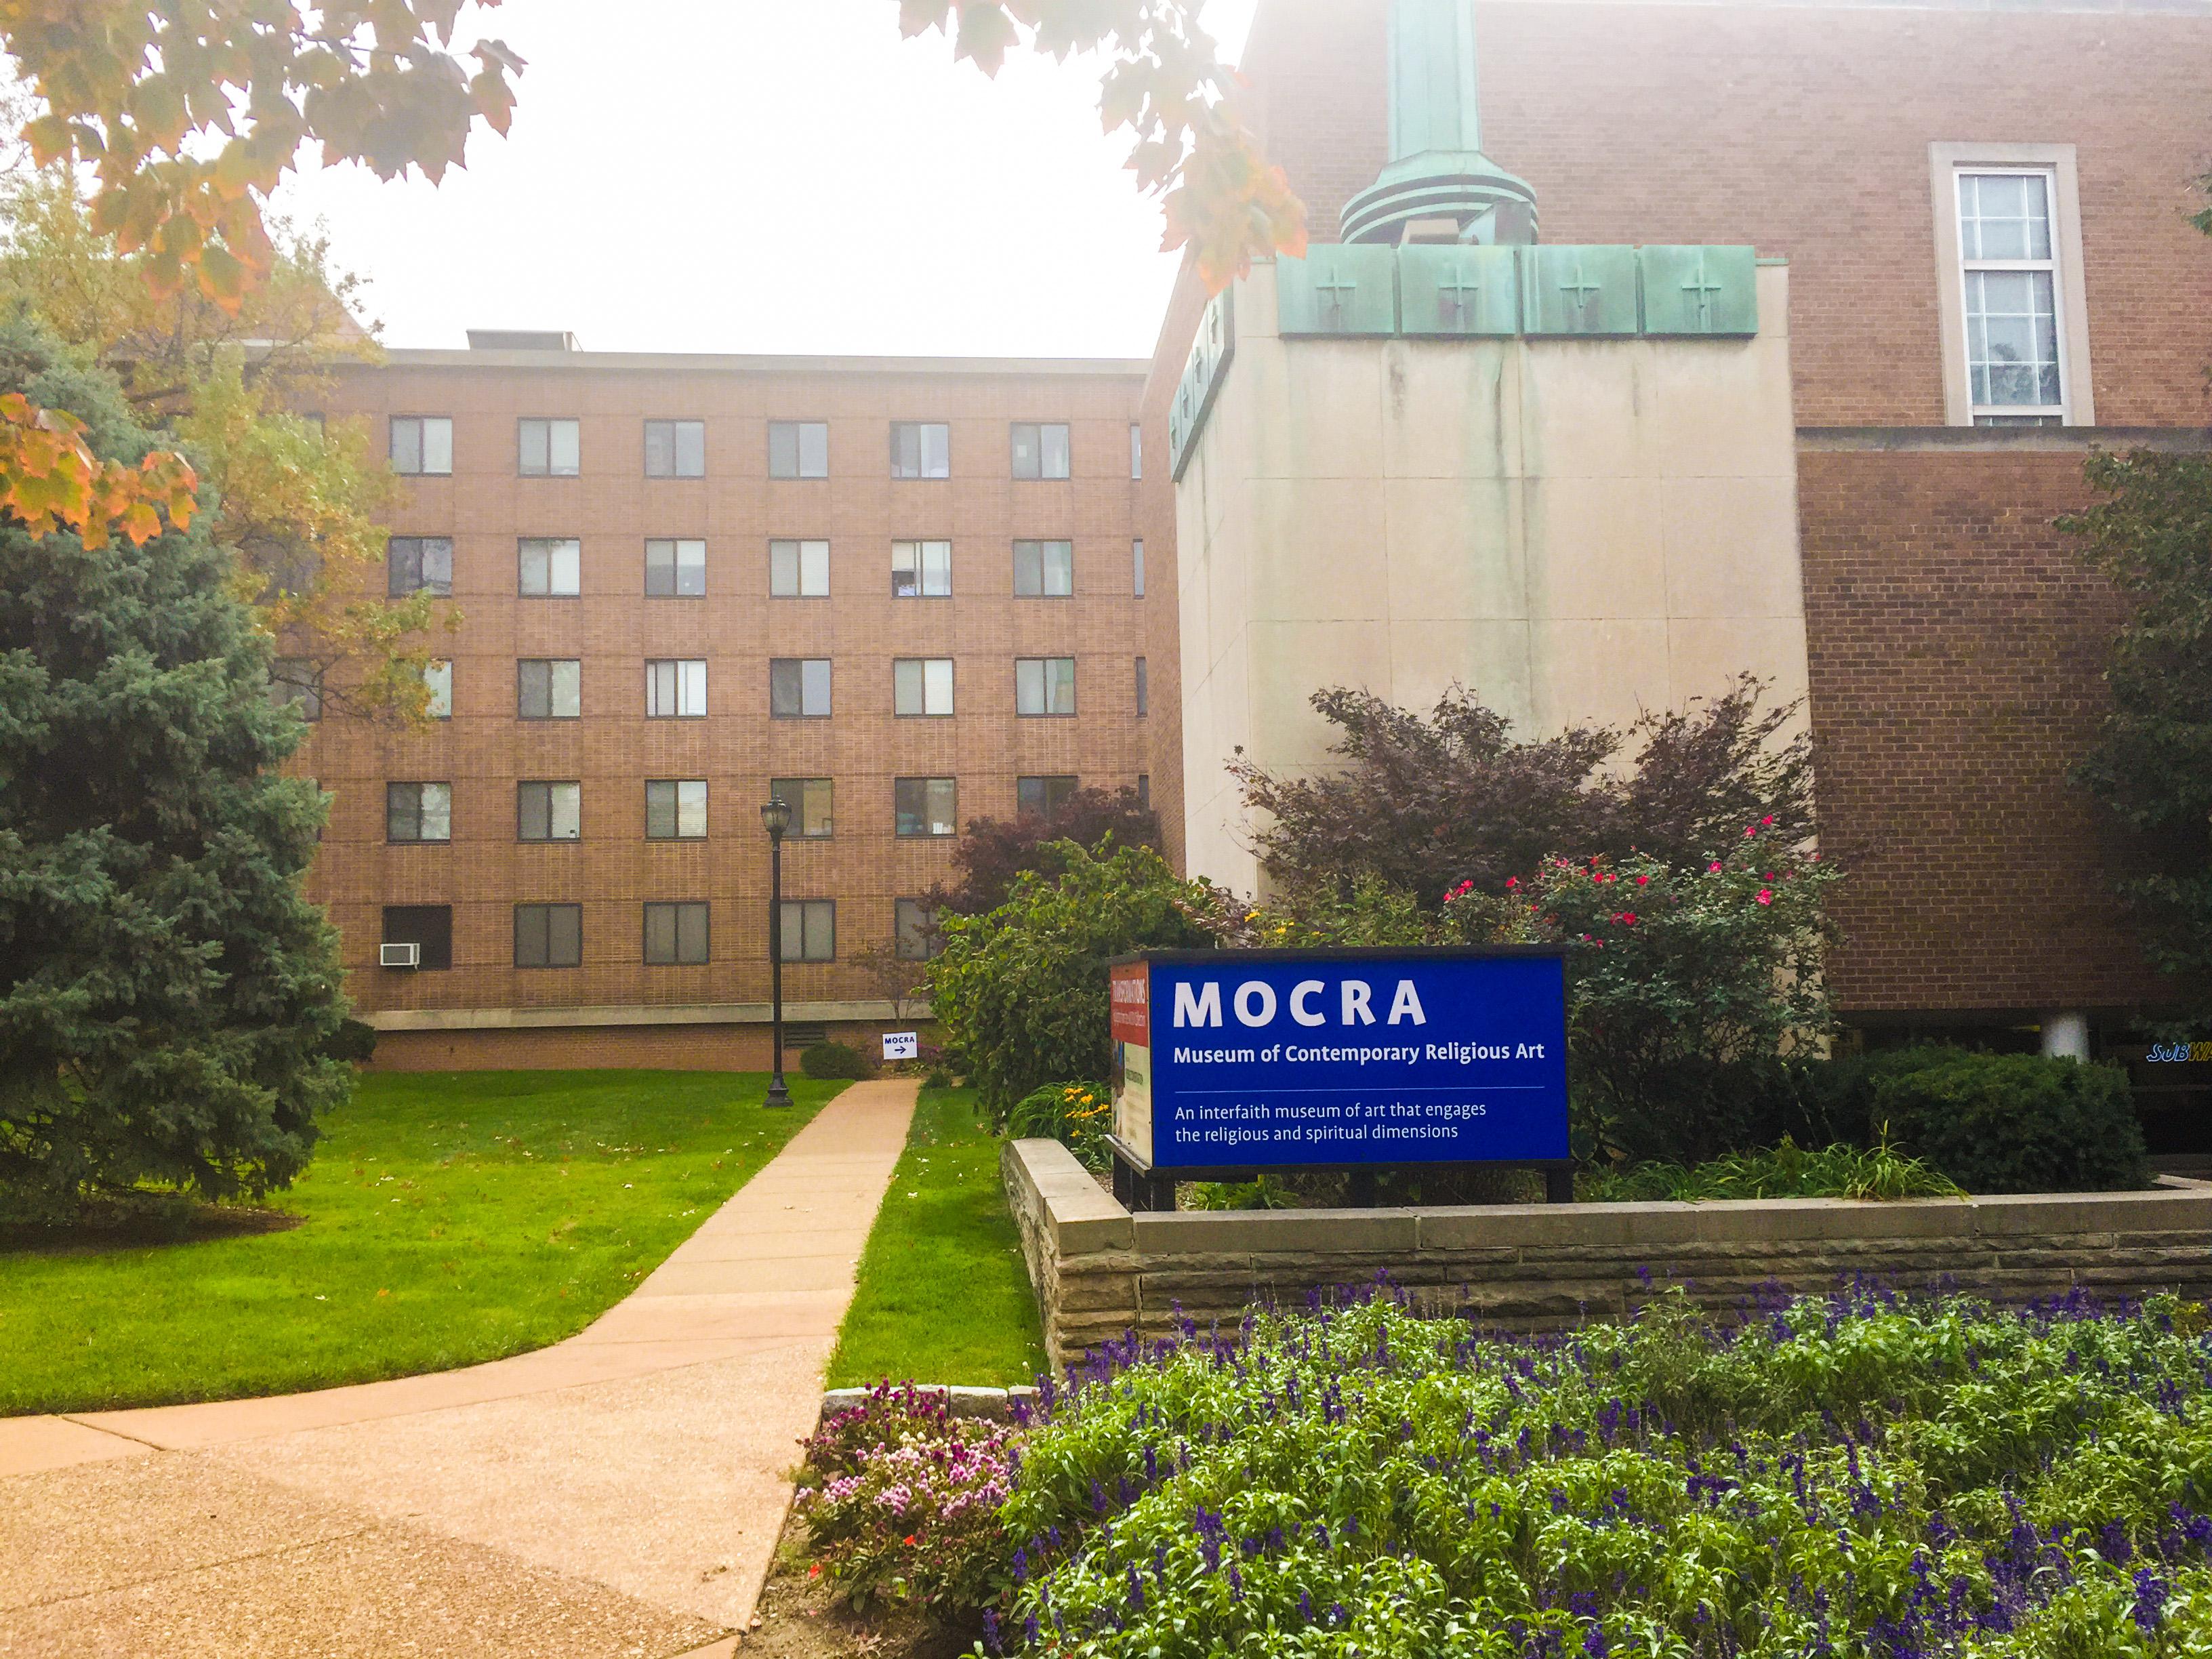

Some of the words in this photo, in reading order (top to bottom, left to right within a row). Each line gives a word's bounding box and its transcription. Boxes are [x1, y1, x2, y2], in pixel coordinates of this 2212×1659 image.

[1173, 979, 1427, 1027] MOCRA
[884, 1036, 915, 1044] MOCRA
[1174, 1047, 1255, 1063] Museum
[1261, 1044, 1281, 1063] of
[1285, 1045, 1420, 1066] Contemporary
[1426, 1042, 1510, 1065] Religious
[1515, 1043, 1545, 1059] Art
[1174, 1107, 1194, 1120] An
[1200, 1103, 1270, 1120] interfaith
[1275, 1107, 1340, 1118] museum
[1345, 1102, 1361, 1118] of
[1364, 1105, 1386, 1118] art
[1389, 1101, 1421, 1117] that
[1425, 1104, 1486, 1120] engages
[1175, 1127, 1200, 1143] the
[1205, 1126, 1269, 1145] religious
[1273, 1125, 1301, 1141] and
[1306, 1124, 1367, 1144] spiritual
[1372, 1124, 1458, 1139] dimensions
